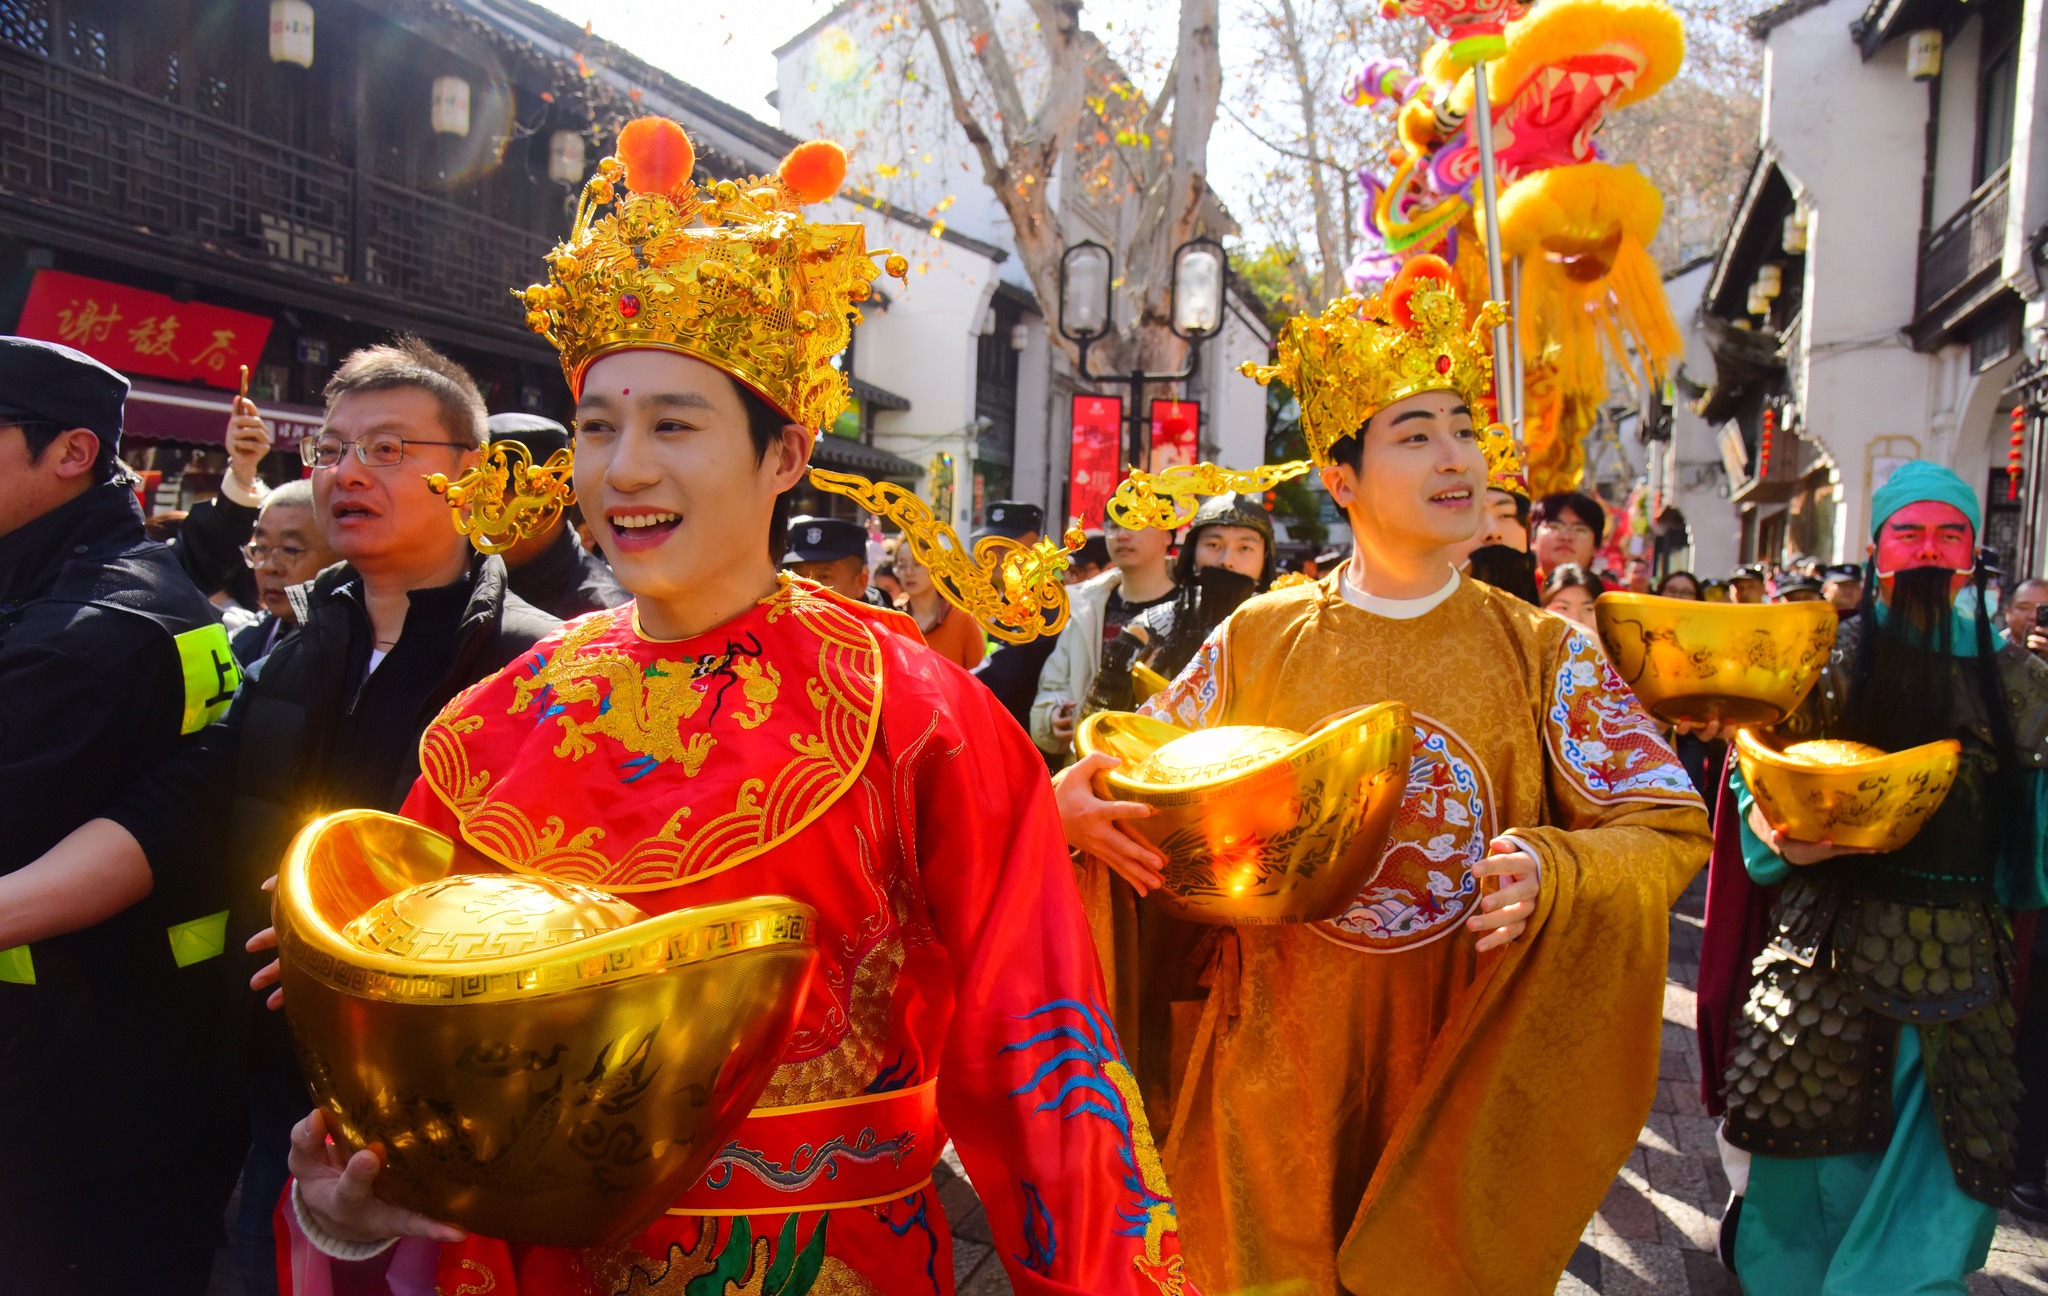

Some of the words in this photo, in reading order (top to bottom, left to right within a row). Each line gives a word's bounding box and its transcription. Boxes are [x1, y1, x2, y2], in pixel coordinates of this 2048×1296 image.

[58, 299, 238, 371] 谢馥春
[205, 645, 243, 709] 上
